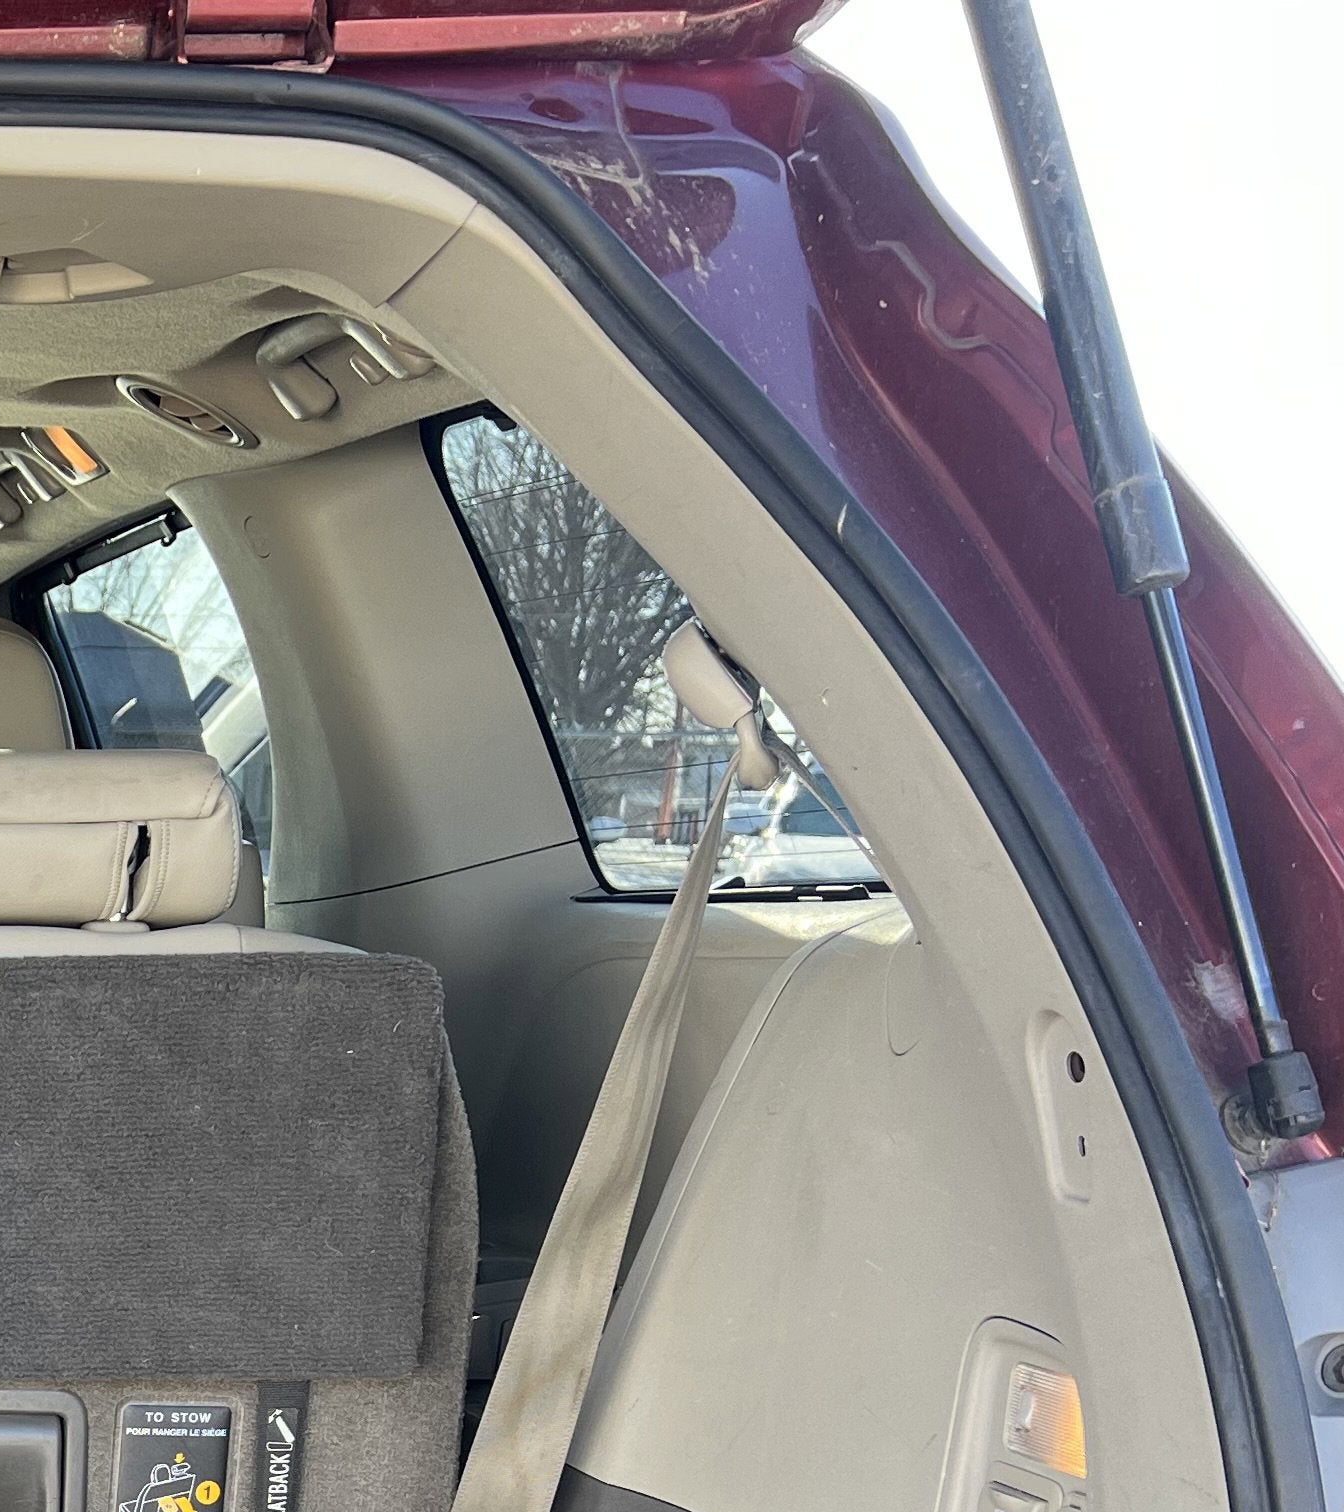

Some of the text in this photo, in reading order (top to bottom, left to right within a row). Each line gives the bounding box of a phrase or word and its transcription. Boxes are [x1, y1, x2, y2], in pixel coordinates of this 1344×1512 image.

[146, 1412, 212, 1423] TO STOW
[126, 1428, 150, 1436] POUR
[152, 1428, 188, 1436] RANGER
